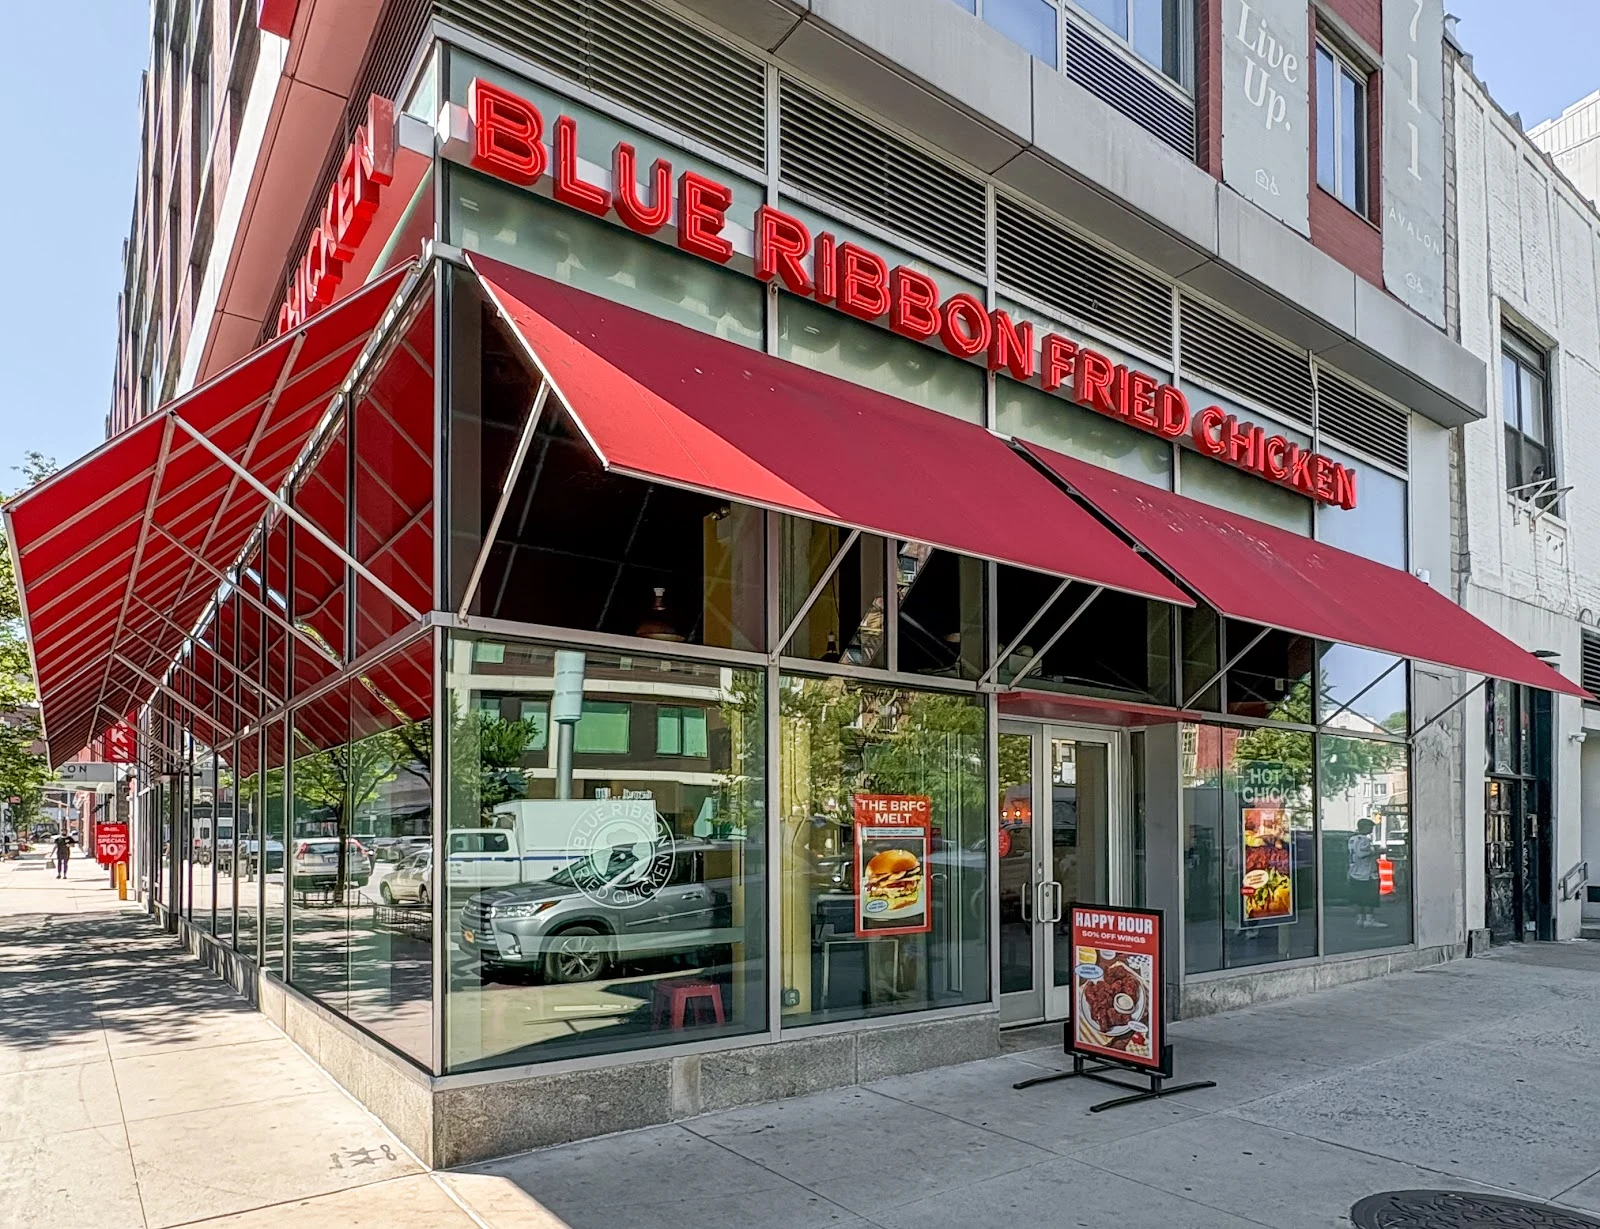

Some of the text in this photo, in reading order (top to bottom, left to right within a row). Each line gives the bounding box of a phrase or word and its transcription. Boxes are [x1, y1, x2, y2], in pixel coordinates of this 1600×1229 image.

[1235, 0, 1298, 83] Live
[1245, 56, 1291, 132] Up.
[1389, 207, 1441, 256] AVALON
[467, 76, 1356, 510] BLUE RIBBON FRIED CHICKEN
[1250, 768, 1281, 785] HOT
[573, 803, 670, 849] BLUE RIBBON
[861, 800, 926, 812] THE BRFC
[875, 813, 912, 824] MELT
[575, 854, 671, 904] FRIED CHICKEN
[1075, 912, 1153, 935] HAPPY HOUR
[1081, 930, 1100, 938] 50%
[1100, 932, 1117, 940] OFF
[1117, 934, 1146, 944] WINGS
